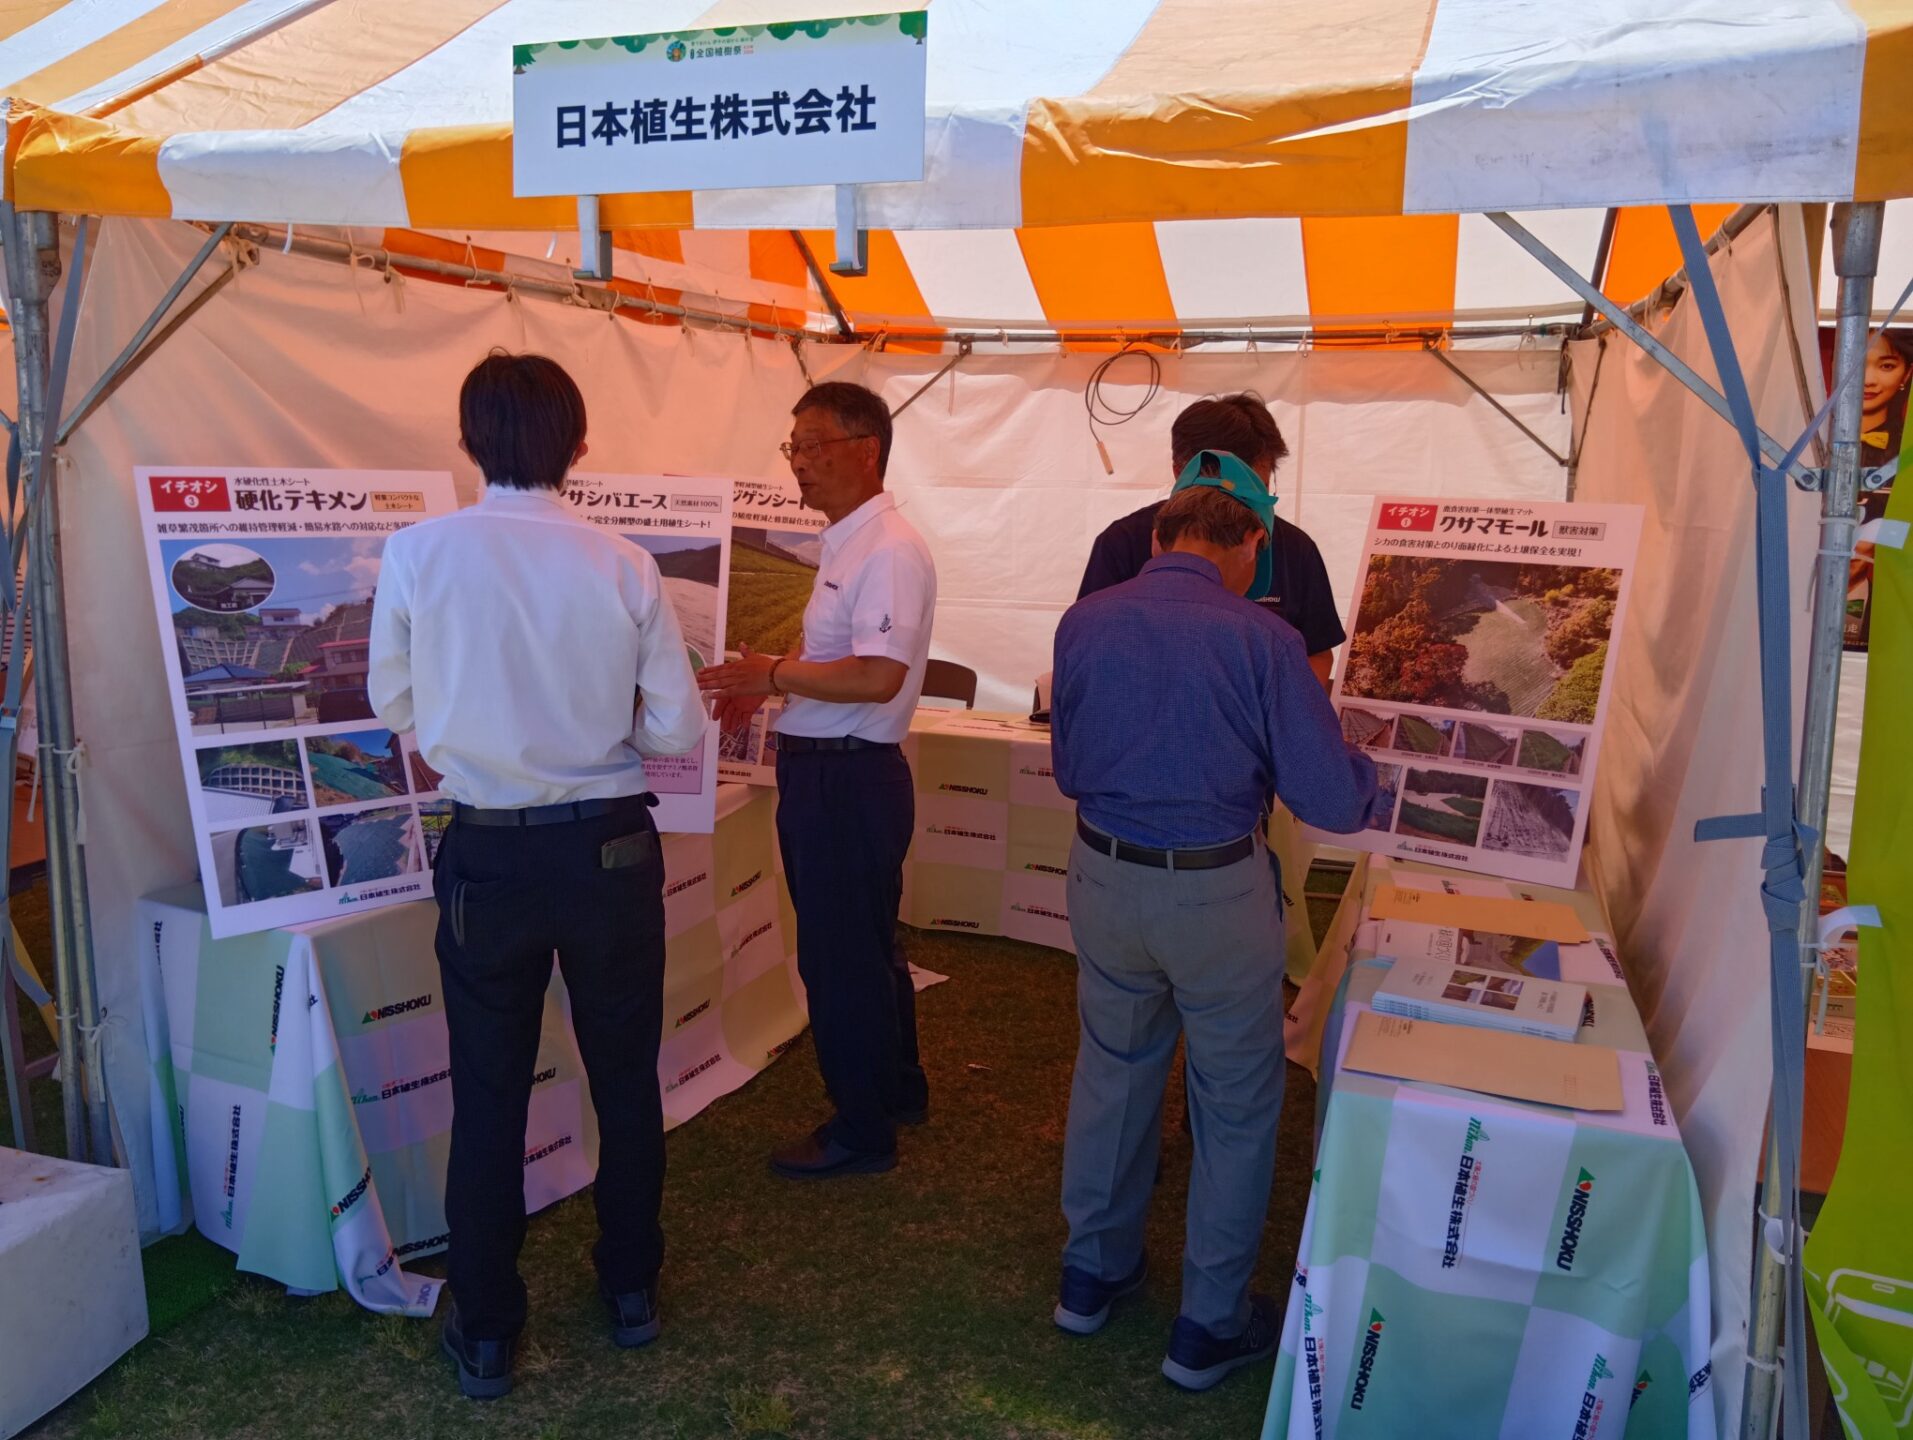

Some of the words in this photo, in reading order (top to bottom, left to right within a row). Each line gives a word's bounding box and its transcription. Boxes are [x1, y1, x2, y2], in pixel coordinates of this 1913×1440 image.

[556, 84, 877, 148] 日本植生株式会社
[160, 480, 218, 494] イチオシ
[234, 489, 367, 511] 硬化テキメン
[1388, 506, 1430, 517] イチオシ
[1440, 516, 1548, 537] クサマモール
[1558, 525, 1599, 536] 獣害対策
[1036, 864, 1068, 875] NISSHOK
[271, 965, 285, 1037] NISSHOKU
[377, 994, 431, 1020] NISSHOKU
[227, 1104, 241, 1197] 日本植生株式会社
[1442, 1155, 1474, 1269] 日本植生株式会社
[1557, 1188, 1590, 1271] NISSHOKU
[1351, 1329, 1381, 1410] NISSHOKU
